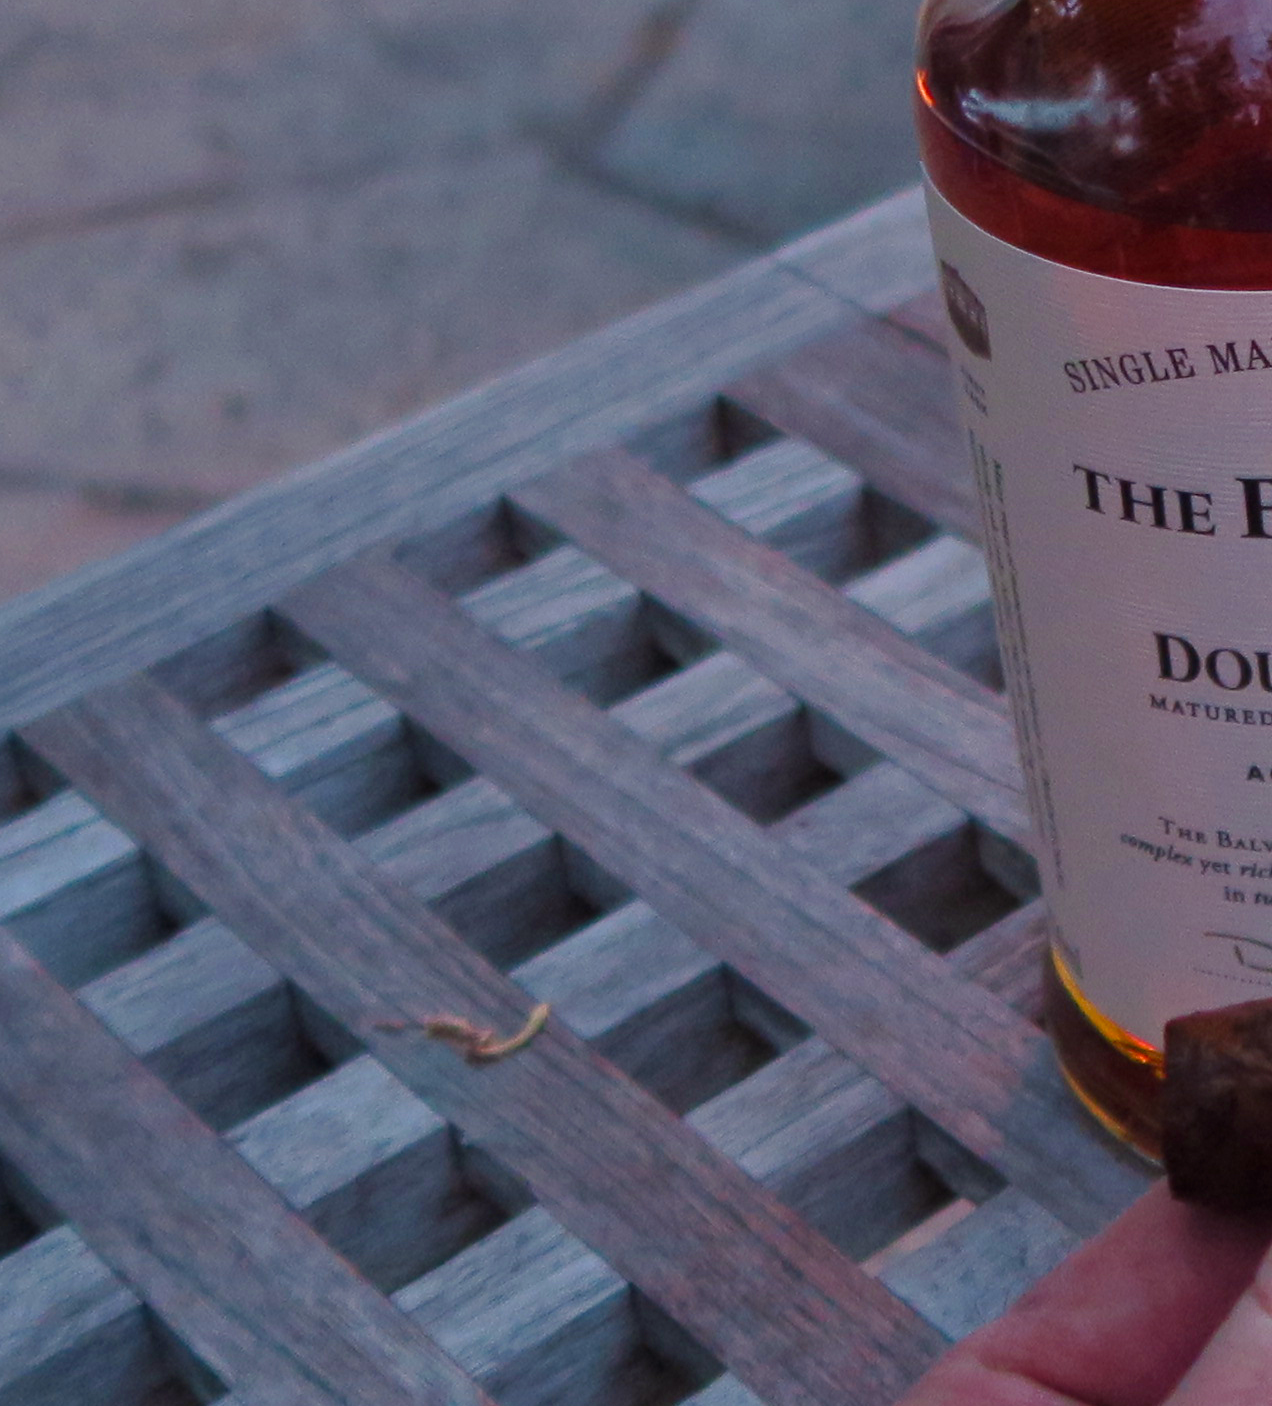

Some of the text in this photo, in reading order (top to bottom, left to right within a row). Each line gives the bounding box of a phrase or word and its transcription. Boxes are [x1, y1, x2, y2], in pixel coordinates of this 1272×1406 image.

[1064, 347, 1196, 394] SINGLE
[1073, 463, 1217, 536] THE
[1120, 833, 1194, 867] complex
[1200, 857, 1232, 876] yet
[1223, 885, 1246, 904] in
